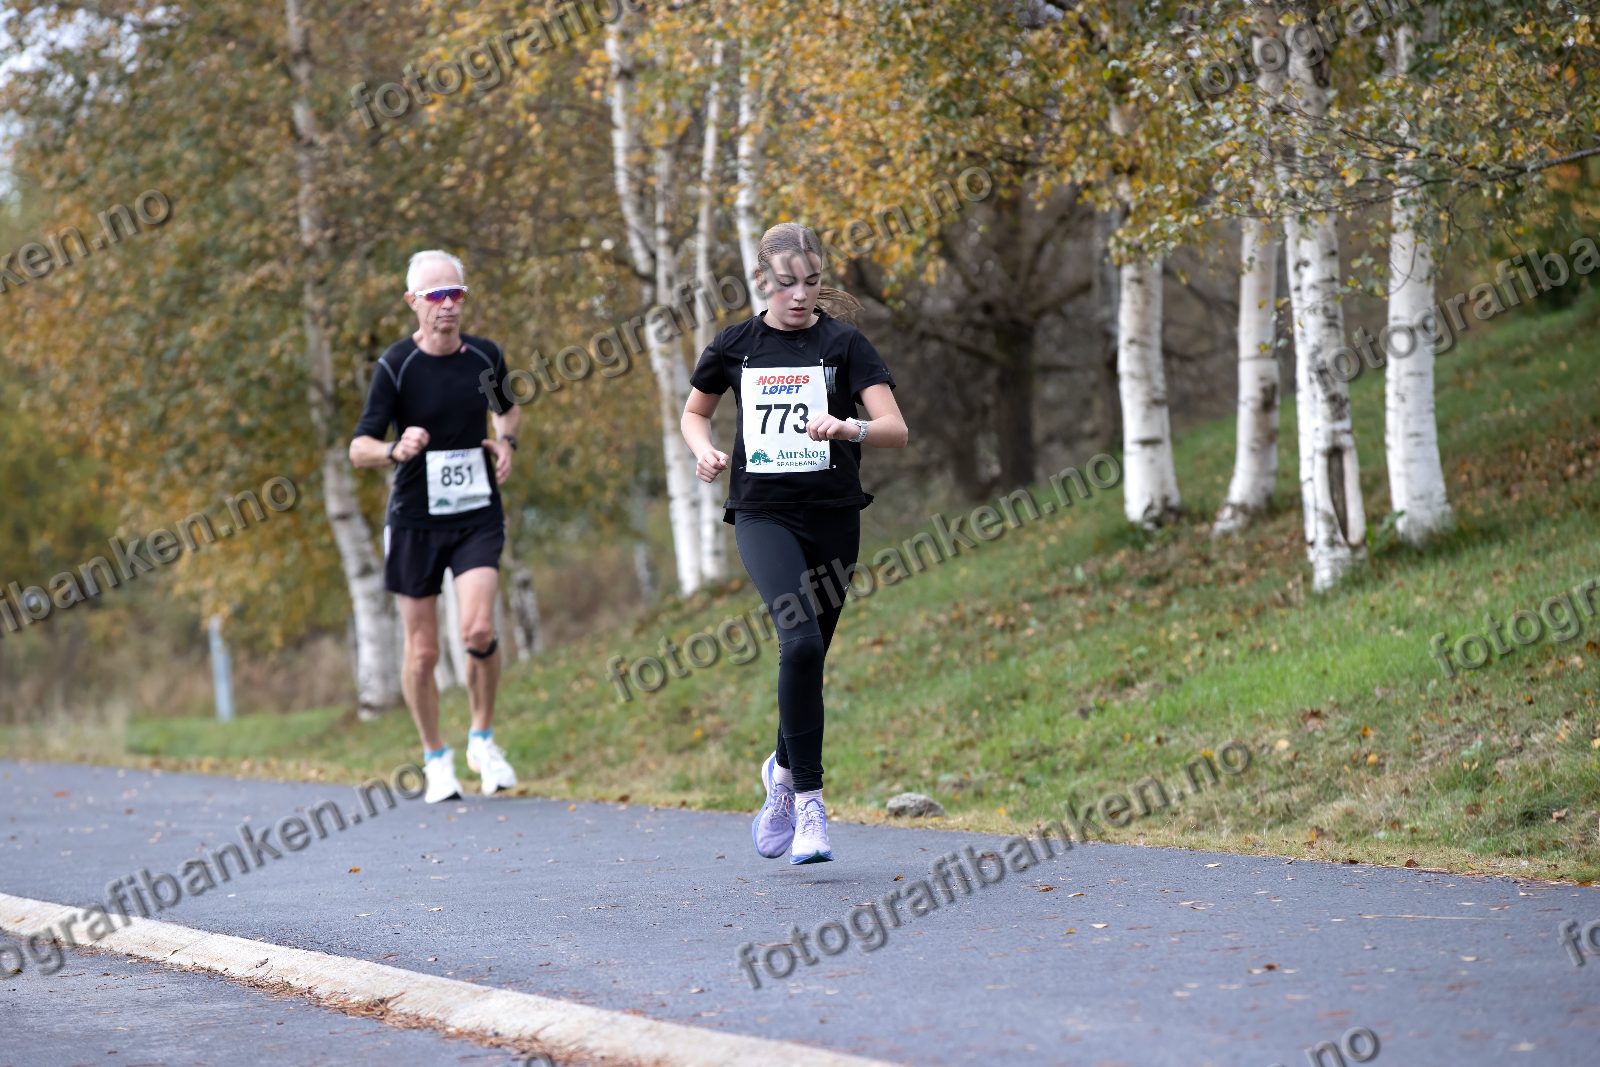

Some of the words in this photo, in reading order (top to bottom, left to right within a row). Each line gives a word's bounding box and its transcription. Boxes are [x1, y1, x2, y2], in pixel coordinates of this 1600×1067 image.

[756, 375, 810, 386] NORGES
[762, 385, 802, 395] LØPET
[756, 403, 809, 434] 773
[776, 448, 827, 461] Aurskog
[441, 464, 473, 487] 851
